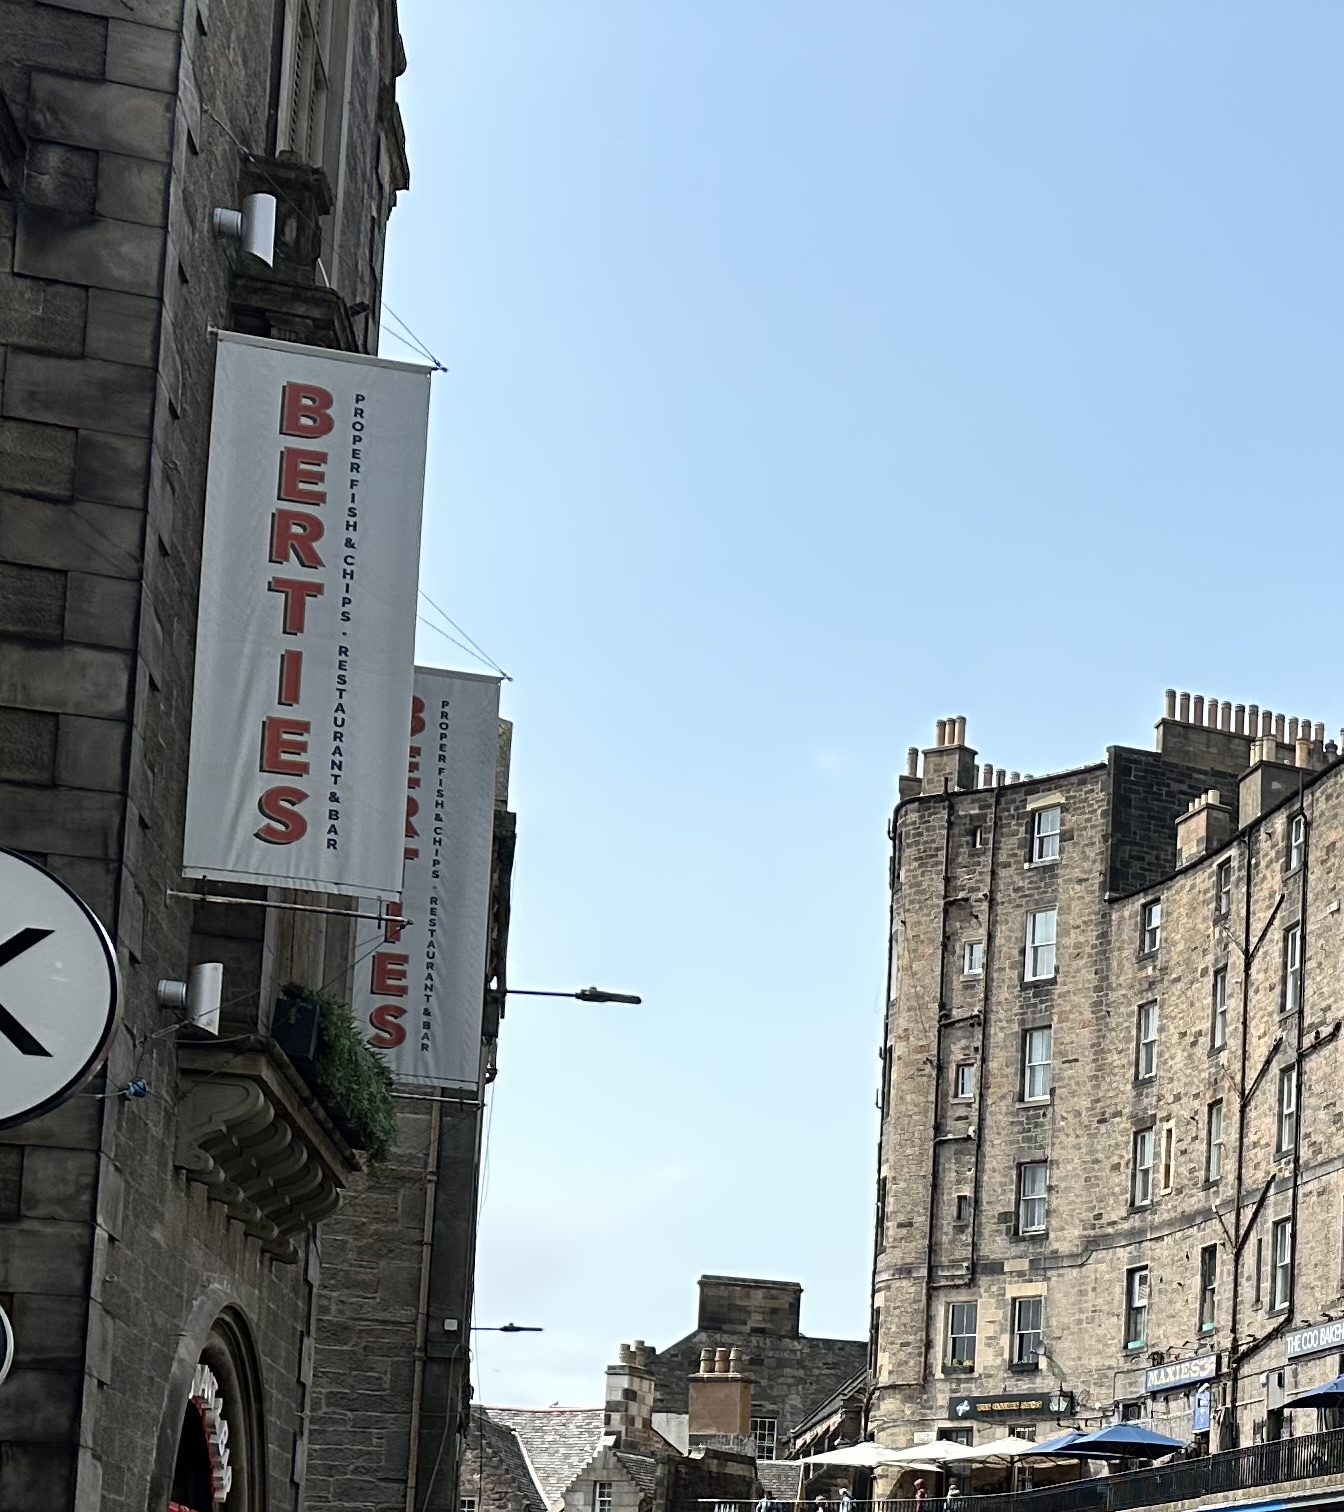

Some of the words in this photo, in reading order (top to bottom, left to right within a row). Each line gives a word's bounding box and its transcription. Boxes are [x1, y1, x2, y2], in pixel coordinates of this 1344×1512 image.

[349, 393, 365, 474] PROPER
[345, 479, 359, 532] FISH
[344, 537, 356, 549] &
[253, 380, 335, 845] BERTIES
[340, 554, 355, 622] CHIPS
[330, 645, 349, 786] RESTAURANT
[438, 700, 450, 763] PROPER
[328, 792, 341, 803] &
[435, 767, 445, 809] FISH
[326, 809, 340, 850] BAR
[431, 827, 443, 879] CHIPS
[424, 896, 438, 1003] RESTAURANT
[421, 1020, 431, 1052] BAR
[1286, 1334, 1302, 1354] THE
[1302, 1330, 1319, 1350] COO
